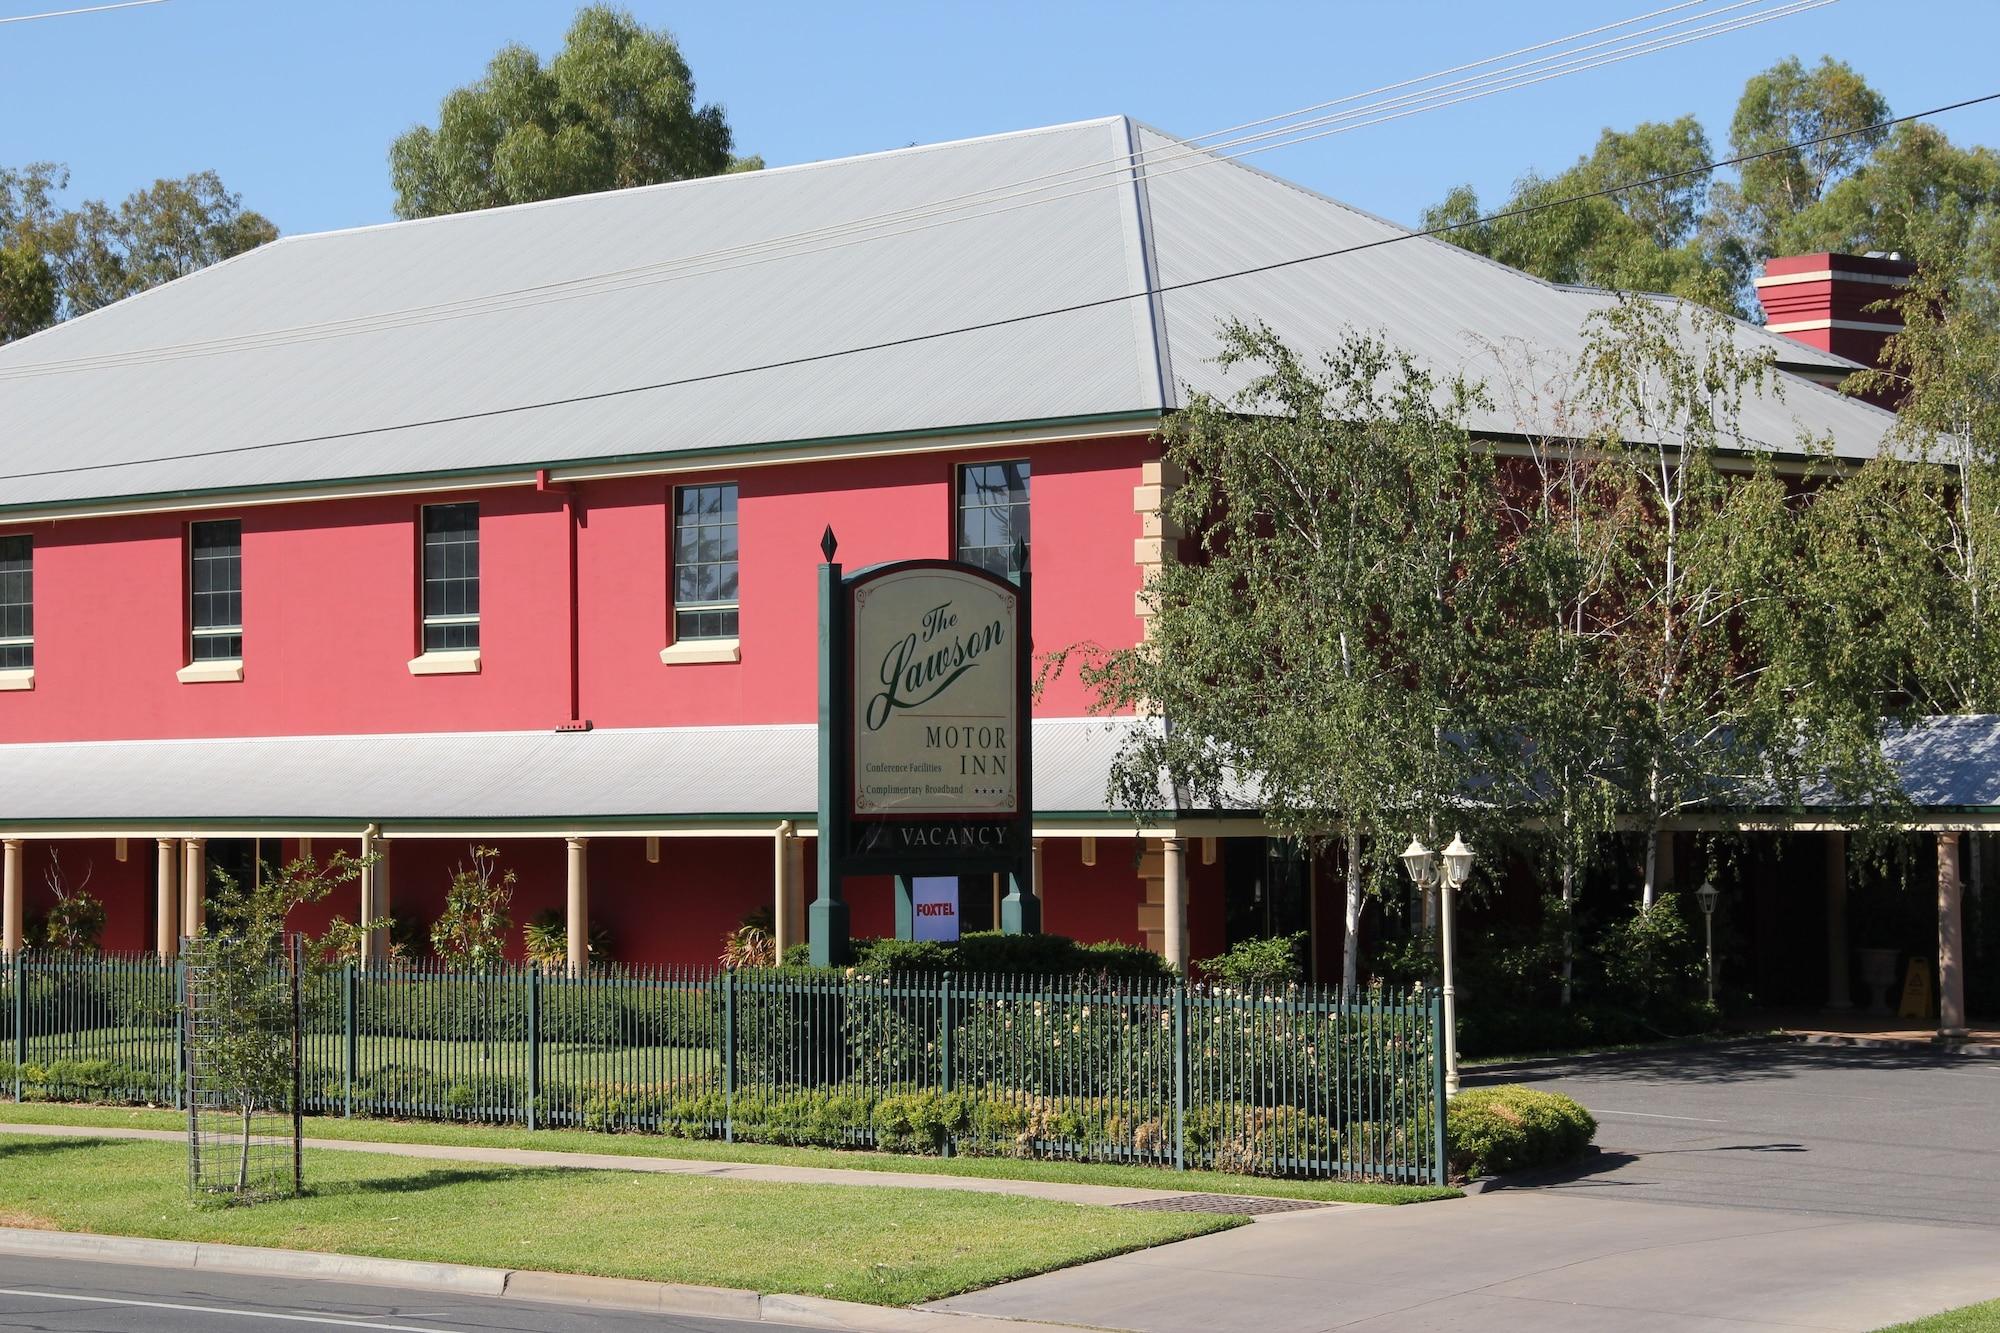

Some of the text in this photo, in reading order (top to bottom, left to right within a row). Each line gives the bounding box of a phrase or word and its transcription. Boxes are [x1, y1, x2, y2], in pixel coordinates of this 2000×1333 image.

[922, 600, 958, 643] The
[866, 619, 1005, 732] Lawson
[926, 726, 1007, 749] MOTOR
[865, 762, 943, 773] Conference Facilities
[960, 755, 1007, 775] INN
[866, 784, 964, 796] Complimentary Broadband
[901, 827, 1008, 846] VACANCY
[916, 902, 955, 917] FOXTEL
